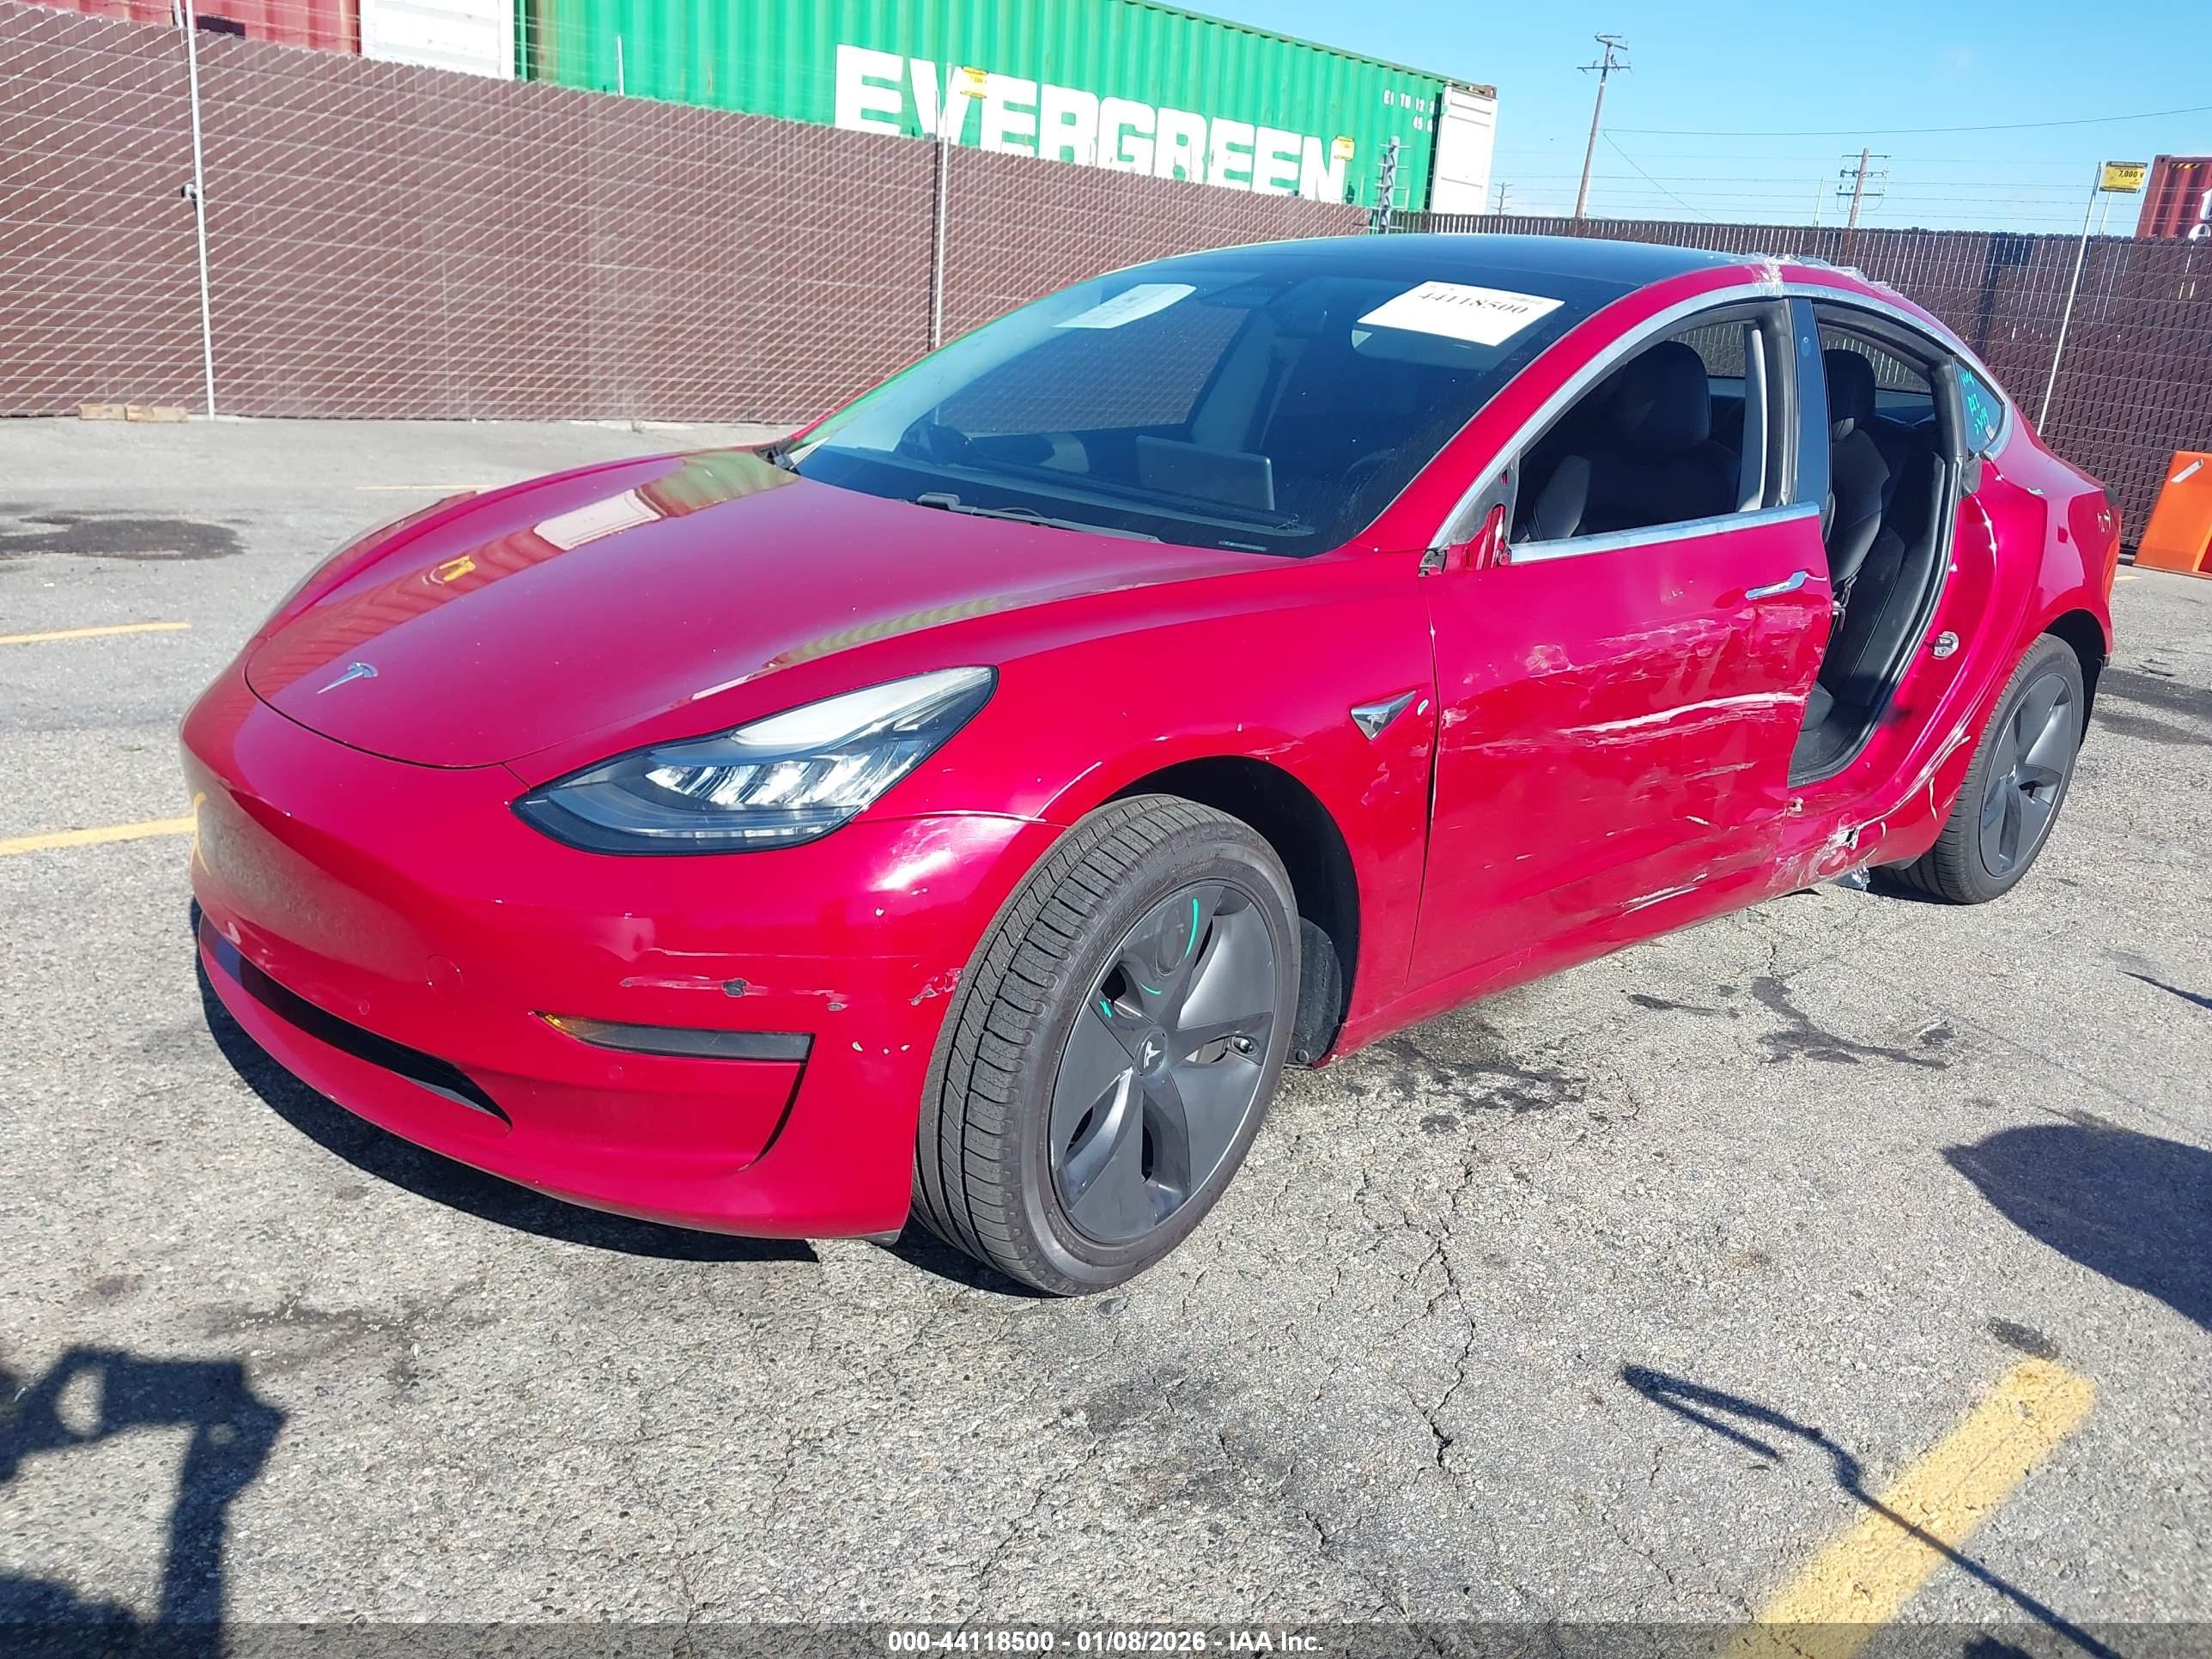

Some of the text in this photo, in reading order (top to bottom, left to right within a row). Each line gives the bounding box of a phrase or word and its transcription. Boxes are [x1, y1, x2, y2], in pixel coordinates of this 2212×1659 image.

[835, 44, 1346, 204] EVERGREEN
[2118, 170, 2138, 179] 7,000
[1418, 292, 1528, 314] 44118500
